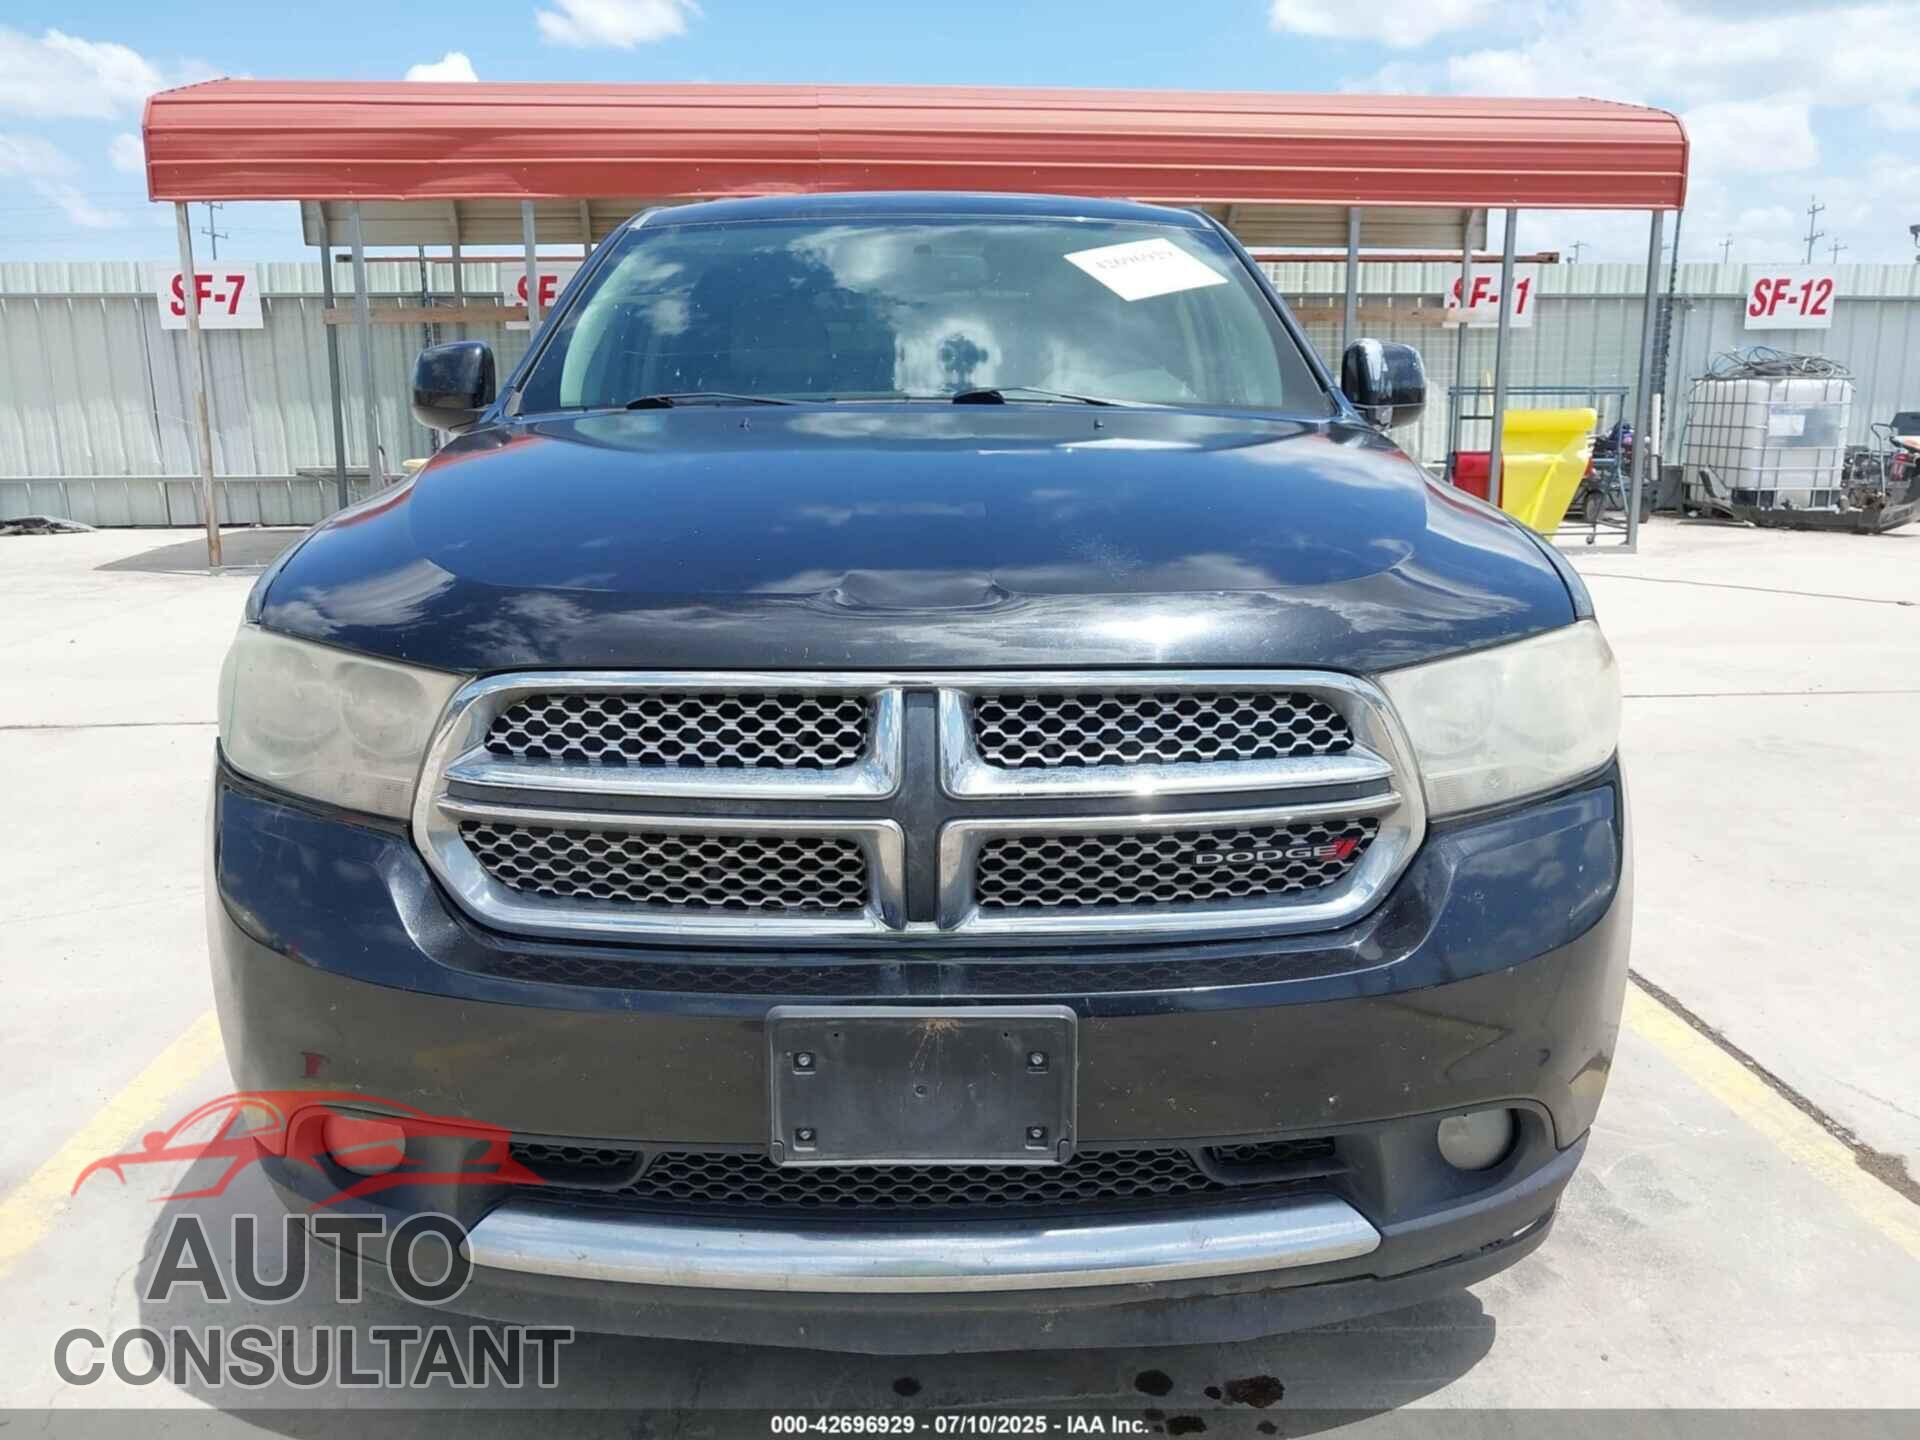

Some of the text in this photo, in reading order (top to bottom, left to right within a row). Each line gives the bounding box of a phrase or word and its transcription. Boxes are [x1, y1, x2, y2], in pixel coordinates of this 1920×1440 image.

[170, 273, 245, 316] SF-7
[1748, 278, 1833, 317] SF-12
[1195, 844, 1337, 865] DODGE
